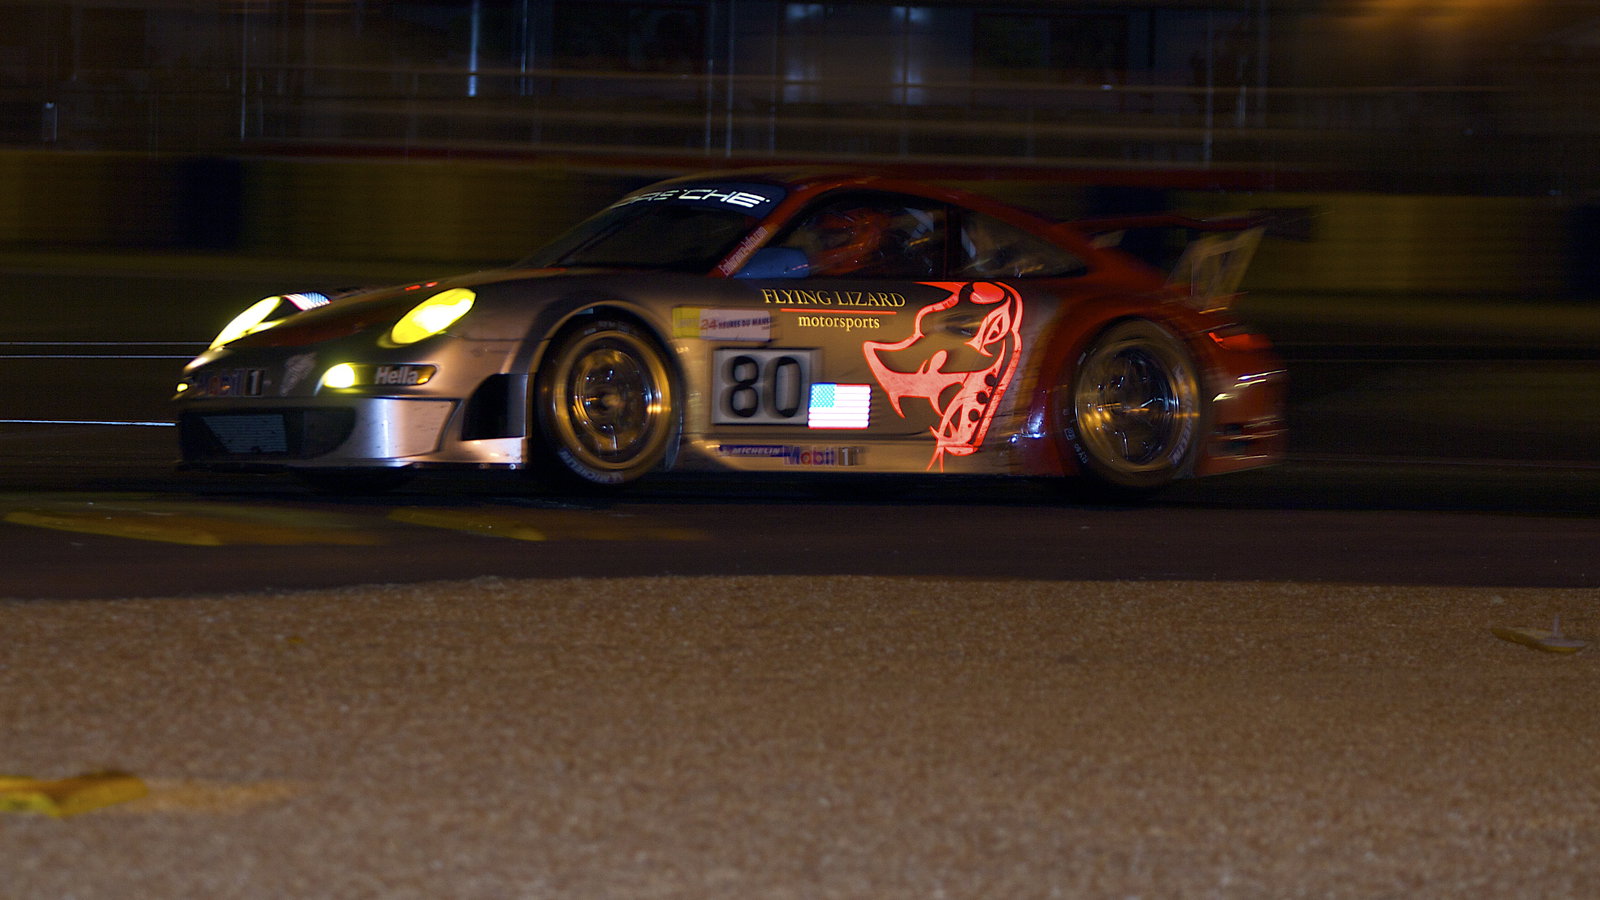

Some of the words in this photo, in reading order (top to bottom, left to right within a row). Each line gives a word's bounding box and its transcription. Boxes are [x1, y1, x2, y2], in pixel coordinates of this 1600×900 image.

[762, 288, 832, 306] FLYING
[837, 290, 907, 308] LIZARD
[700, 318, 718, 330] 24
[798, 315, 881, 332] motorsports
[374, 365, 420, 386] Hella
[727, 354, 802, 418] 80
[732, 445, 781, 455] MICHELIN
[783, 445, 835, 466] Mobil
